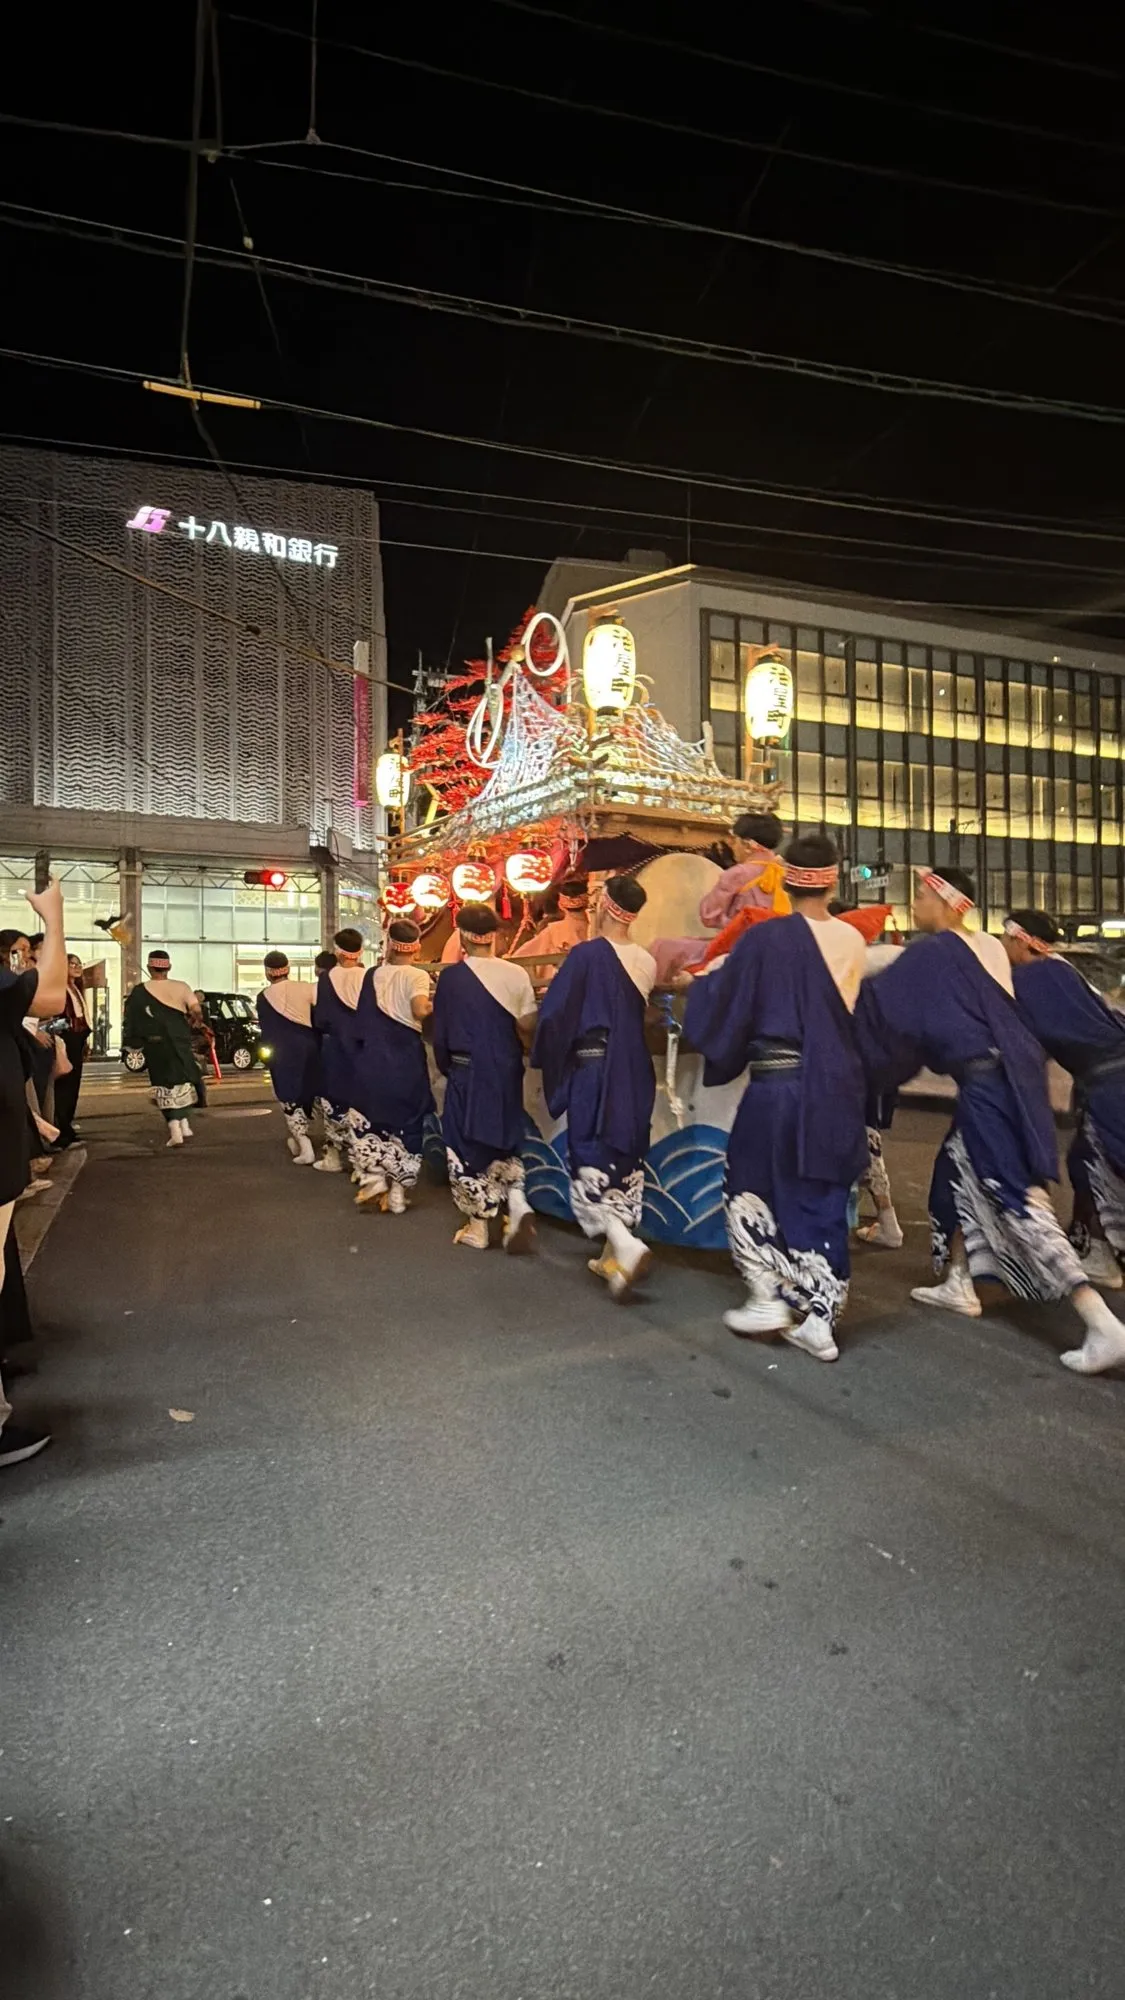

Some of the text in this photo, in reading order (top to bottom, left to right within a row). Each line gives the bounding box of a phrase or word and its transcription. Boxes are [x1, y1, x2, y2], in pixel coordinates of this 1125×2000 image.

[178, 516, 339, 568] 十八親和銀行
